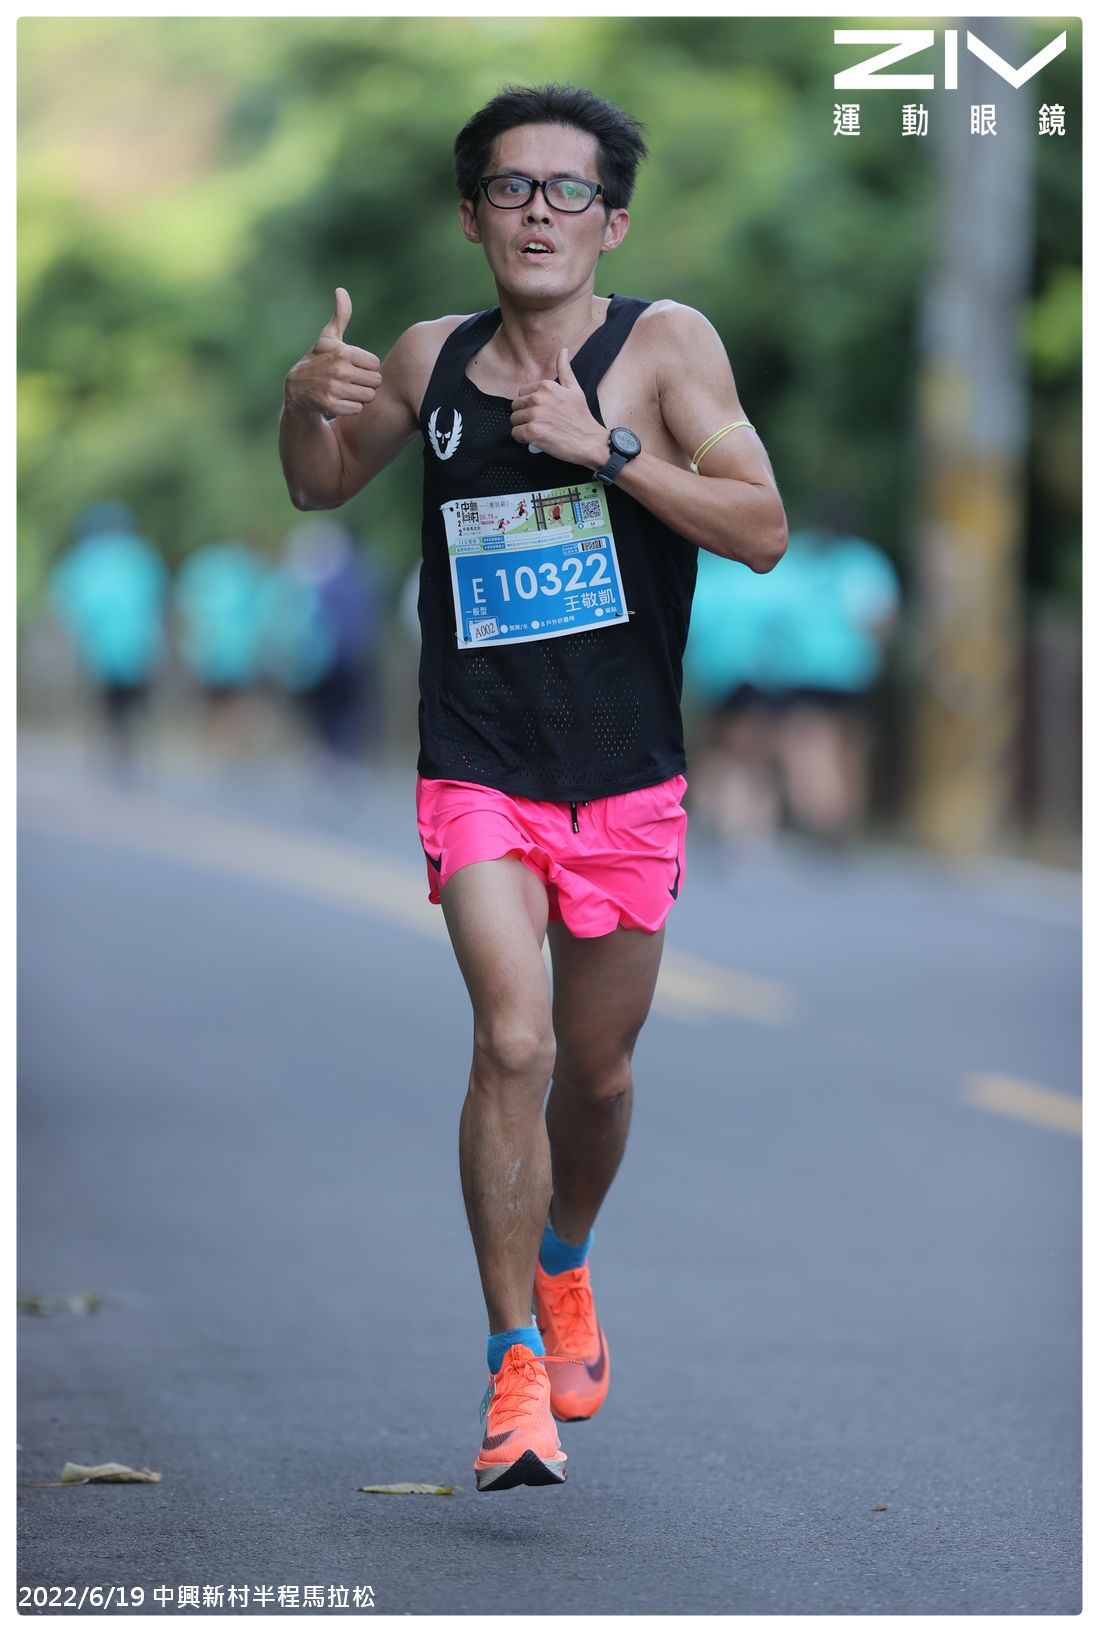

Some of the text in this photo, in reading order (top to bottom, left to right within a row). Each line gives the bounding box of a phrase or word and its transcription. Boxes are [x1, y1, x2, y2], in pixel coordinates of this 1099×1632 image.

[472, 554, 611, 605] E 10322
[564, 588, 616, 612] 王敬凱
[465, 606, 488, 617] 一般型
[475, 622, 496, 638] A002
